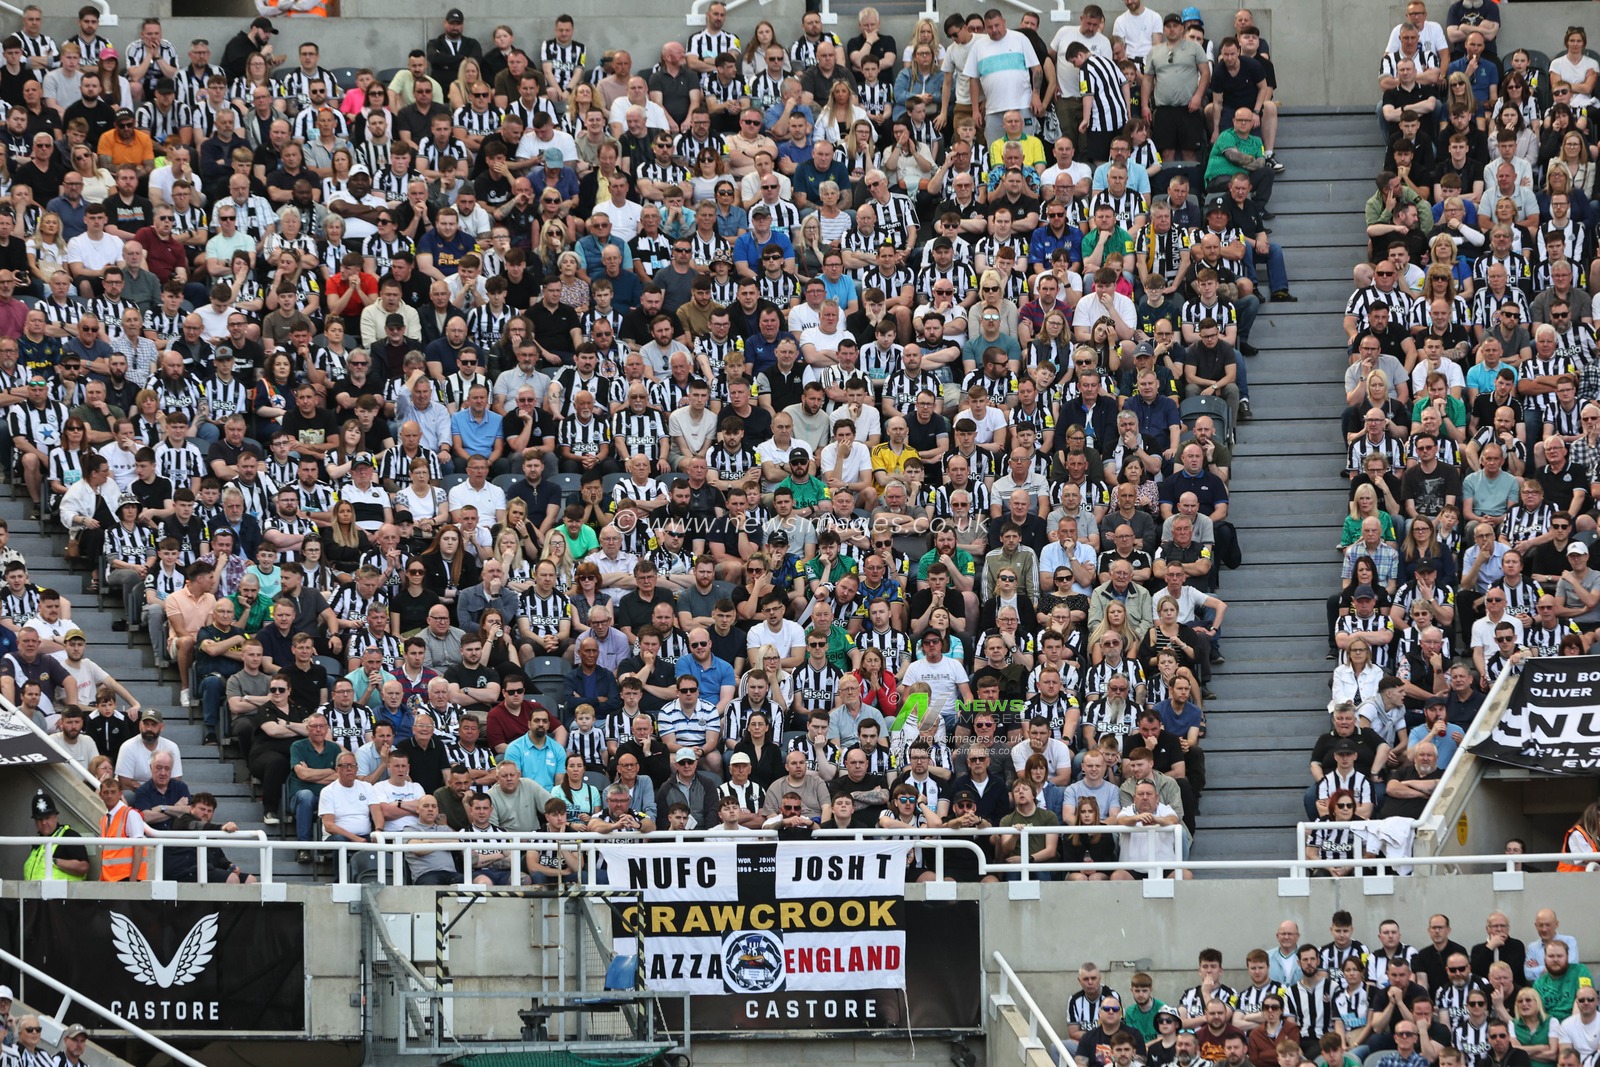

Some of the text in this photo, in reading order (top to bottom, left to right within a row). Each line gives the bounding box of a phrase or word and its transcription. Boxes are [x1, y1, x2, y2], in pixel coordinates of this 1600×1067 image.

[1563, 344, 1582, 357] sela
[990, 394, 1004, 403] ela
[636, 435, 655, 444] sela
[580, 444, 598, 452] sela
[541, 616, 559, 625] sela
[882, 648, 896, 657] ela
[1532, 672, 1566, 682] STU
[813, 690, 831, 700] sela
[1530, 688, 1592, 698] OLIVER
[1050, 718, 1064, 728] ela
[342, 727, 361, 736] sela
[1107, 724, 1130, 733] sela
[1330, 842, 1352, 852] sela
[628, 856, 716, 890] NUFC
[792, 854, 892, 882] JOSH T
[622, 900, 897, 932] CRAWCROOK
[784, 946, 901, 974] ENGLAND
[650, 954, 723, 980] AZZA
[111, 1000, 219, 1020] CASTORE
[746, 1000, 878, 1018] CASTORE
